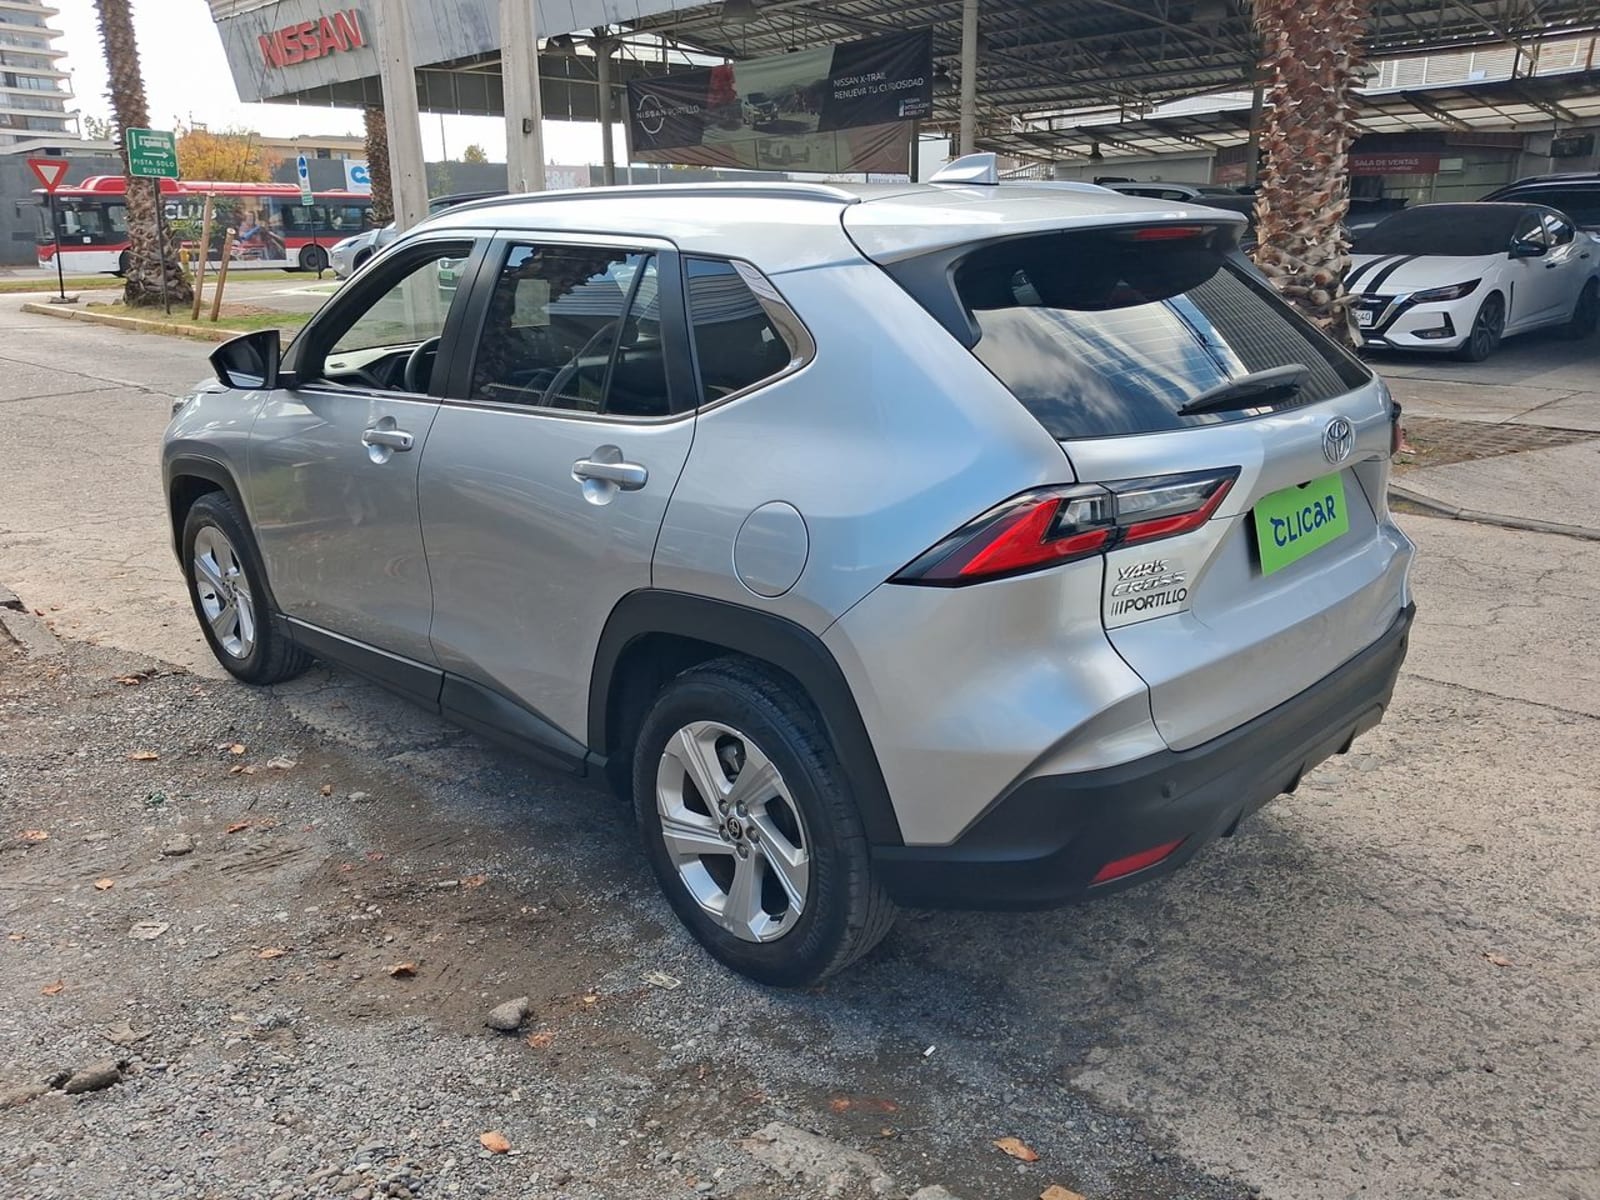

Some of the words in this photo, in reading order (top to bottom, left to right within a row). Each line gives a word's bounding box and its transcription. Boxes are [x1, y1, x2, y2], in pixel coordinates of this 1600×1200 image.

[257, 8, 364, 69] NISSAN
[833, 76, 859, 88] NISSAN
[834, 87, 867, 100] RENUEVA
[868, 86, 878, 94] TU
[879, 77, 924, 93] CURIOSIDAD
[133, 158, 154, 166] PISTA
[156, 160, 175, 168] SOLO
[143, 167, 166, 175] BUSES
[1354, 159, 1375, 167] SALA
[1387, 158, 1419, 166] VENTAS
[1118, 559, 1169, 581] YARIS
[1112, 570, 1187, 597] CROSS
